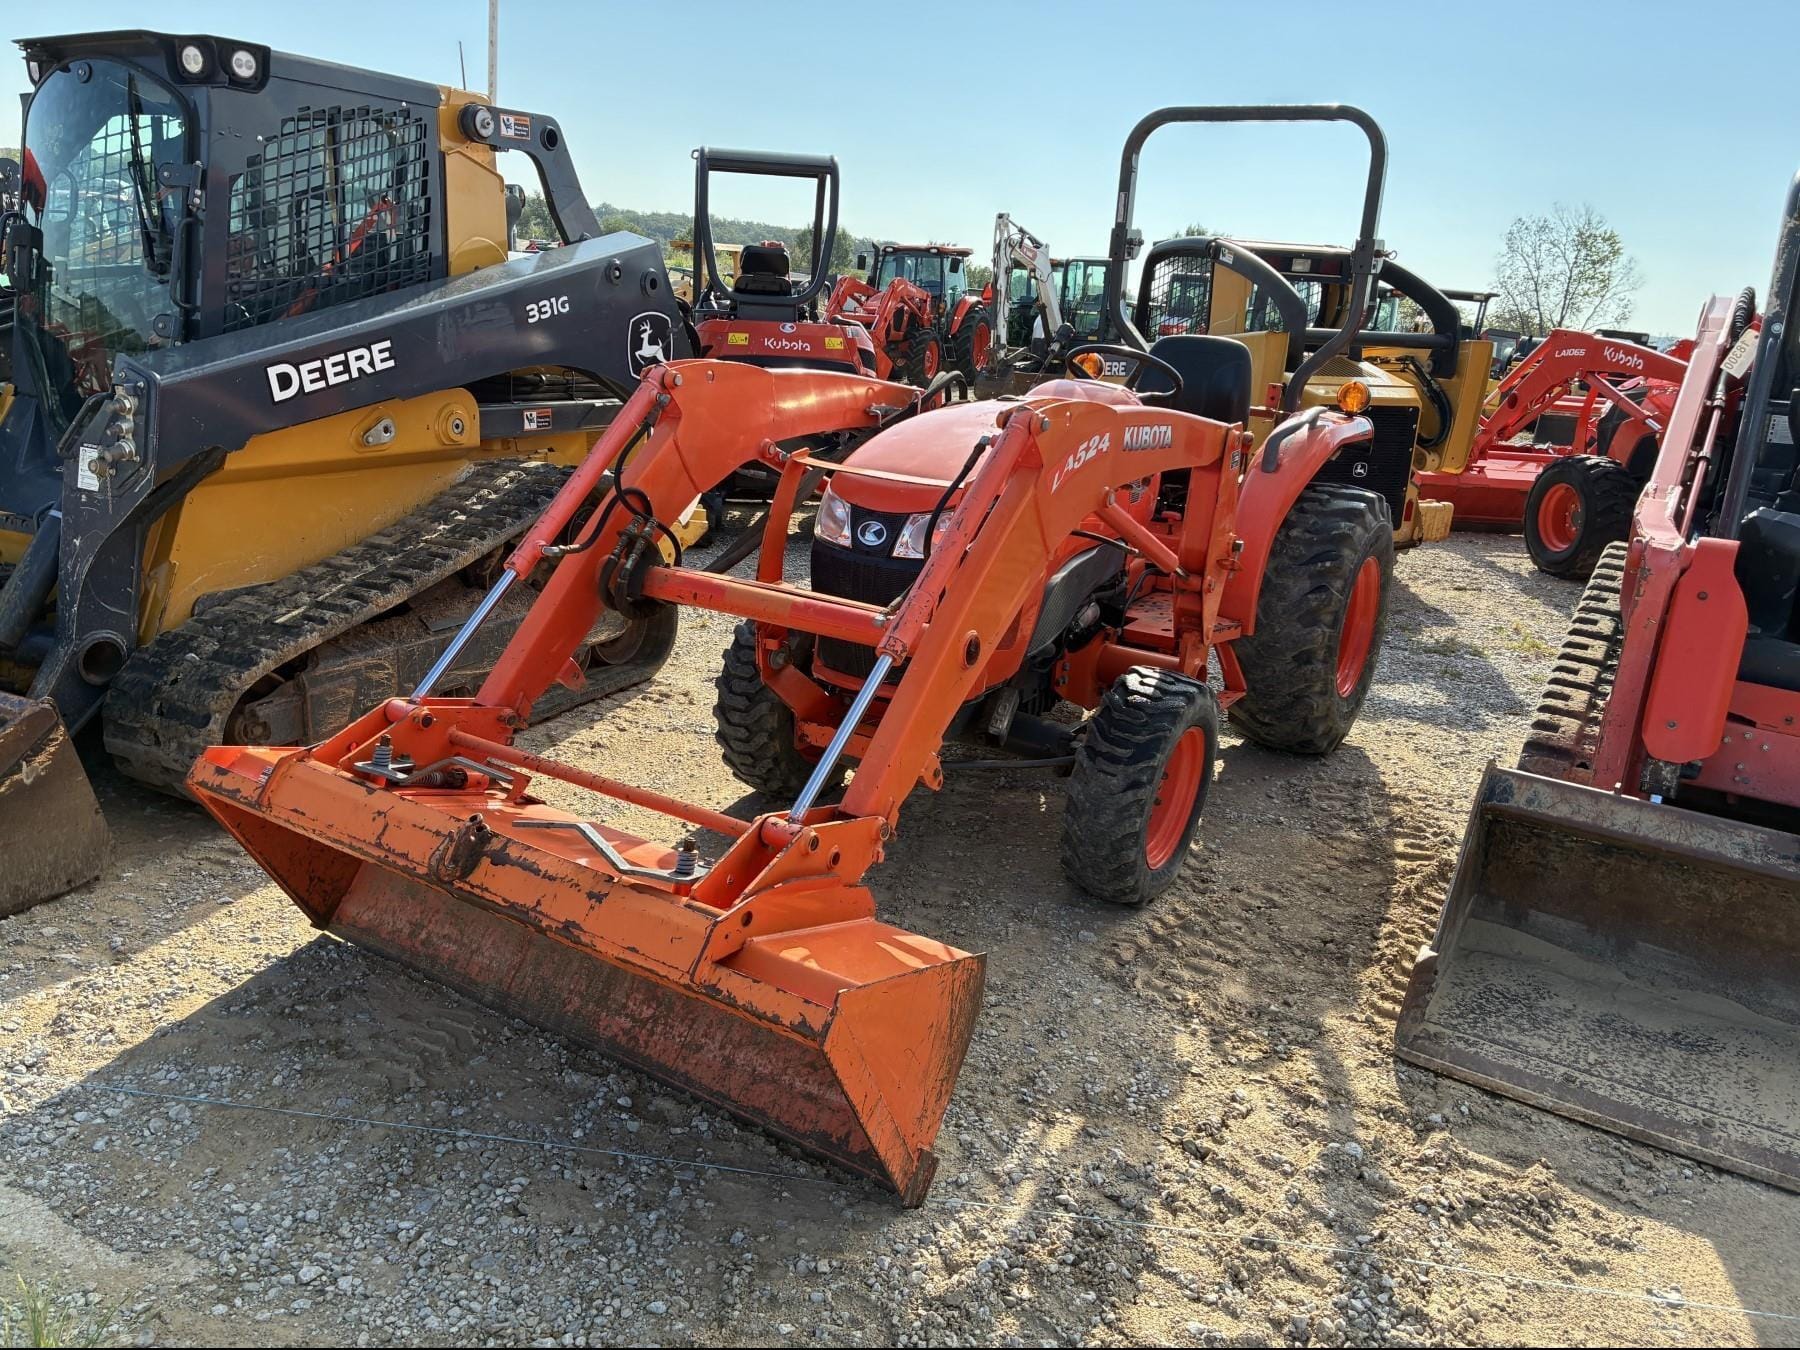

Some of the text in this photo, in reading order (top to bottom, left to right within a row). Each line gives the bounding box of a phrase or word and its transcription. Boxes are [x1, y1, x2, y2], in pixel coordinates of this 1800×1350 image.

[526, 295, 570, 323] 331G
[764, 337, 811, 352] Kubota
[1603, 345, 1644, 370] Kubota
[266, 339, 396, 402] DEERE
[1104, 361, 1127, 376] ERE
[1123, 424, 1172, 451] KUBOTA
[1050, 431, 1110, 495] LA524
